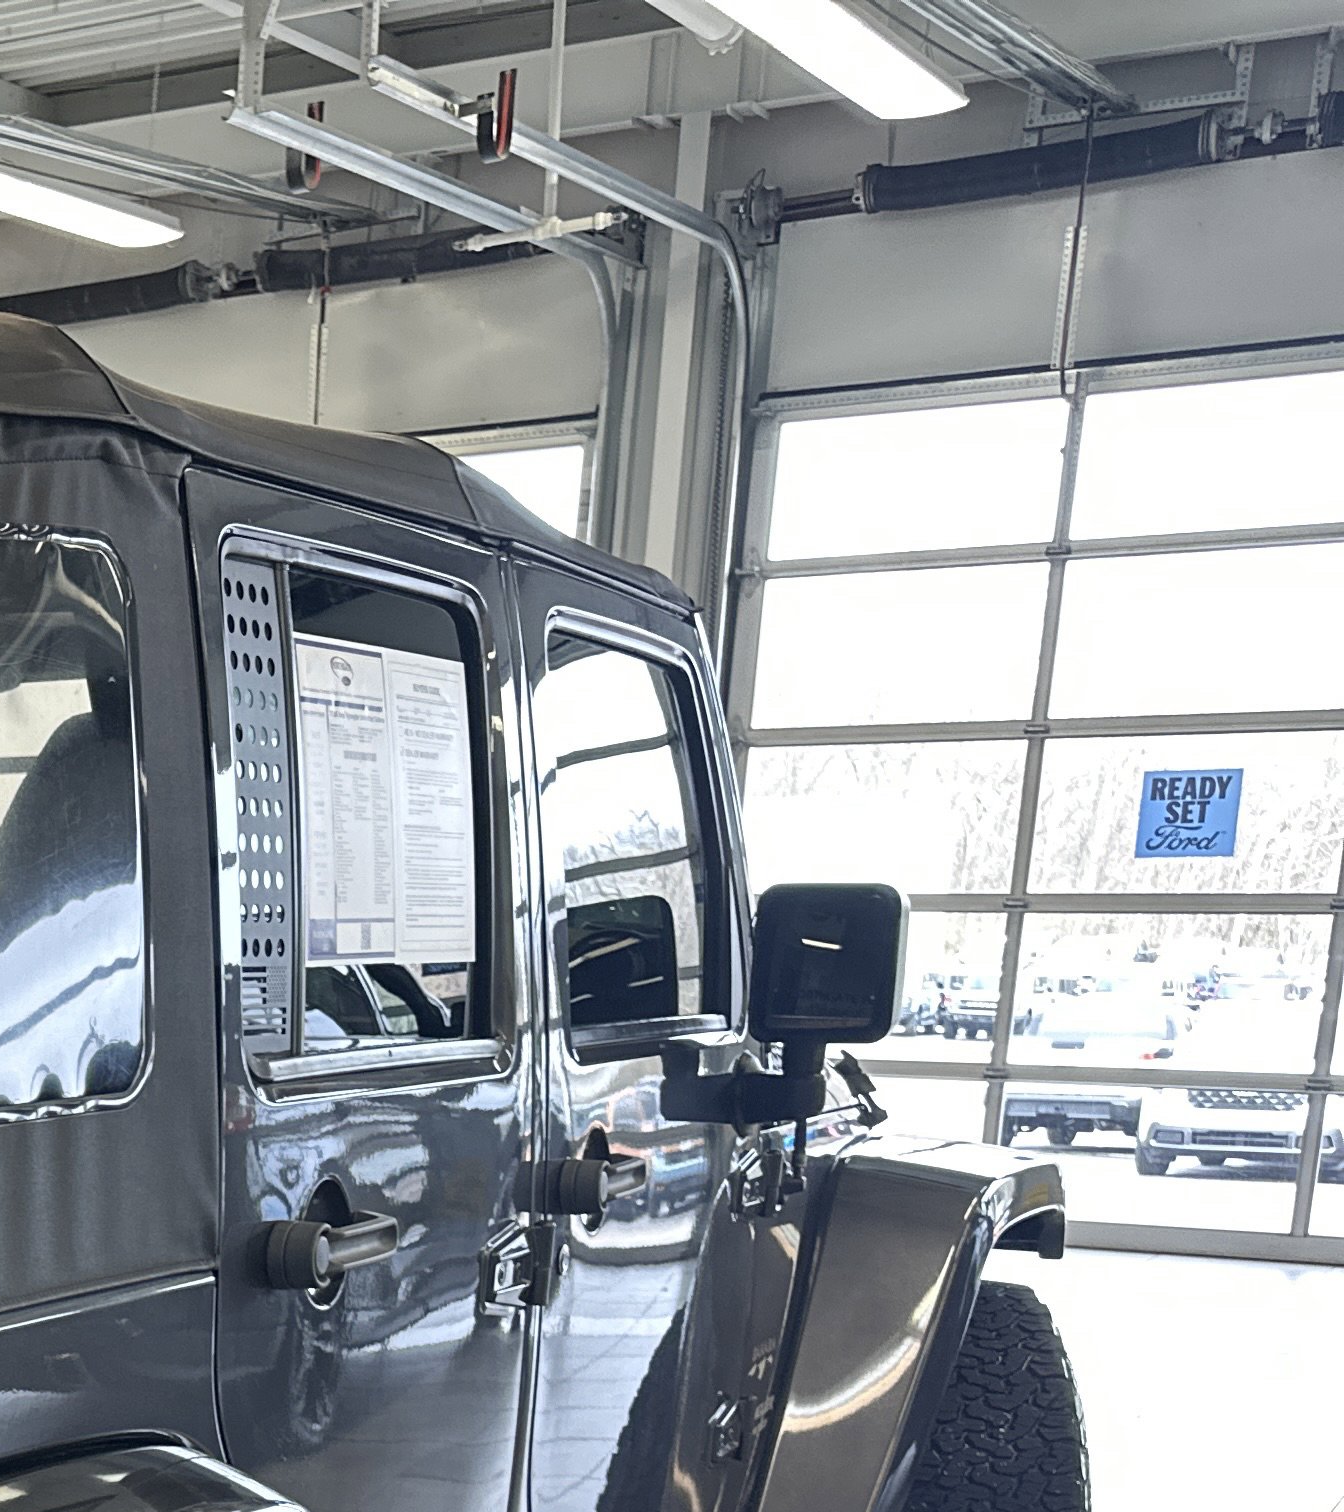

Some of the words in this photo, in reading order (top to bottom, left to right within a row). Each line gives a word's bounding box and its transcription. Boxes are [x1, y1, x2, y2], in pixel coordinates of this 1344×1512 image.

[1150, 776, 1234, 801] READY
[1164, 801, 1211, 824] SET
[1145, 825, 1220, 851] Ford
